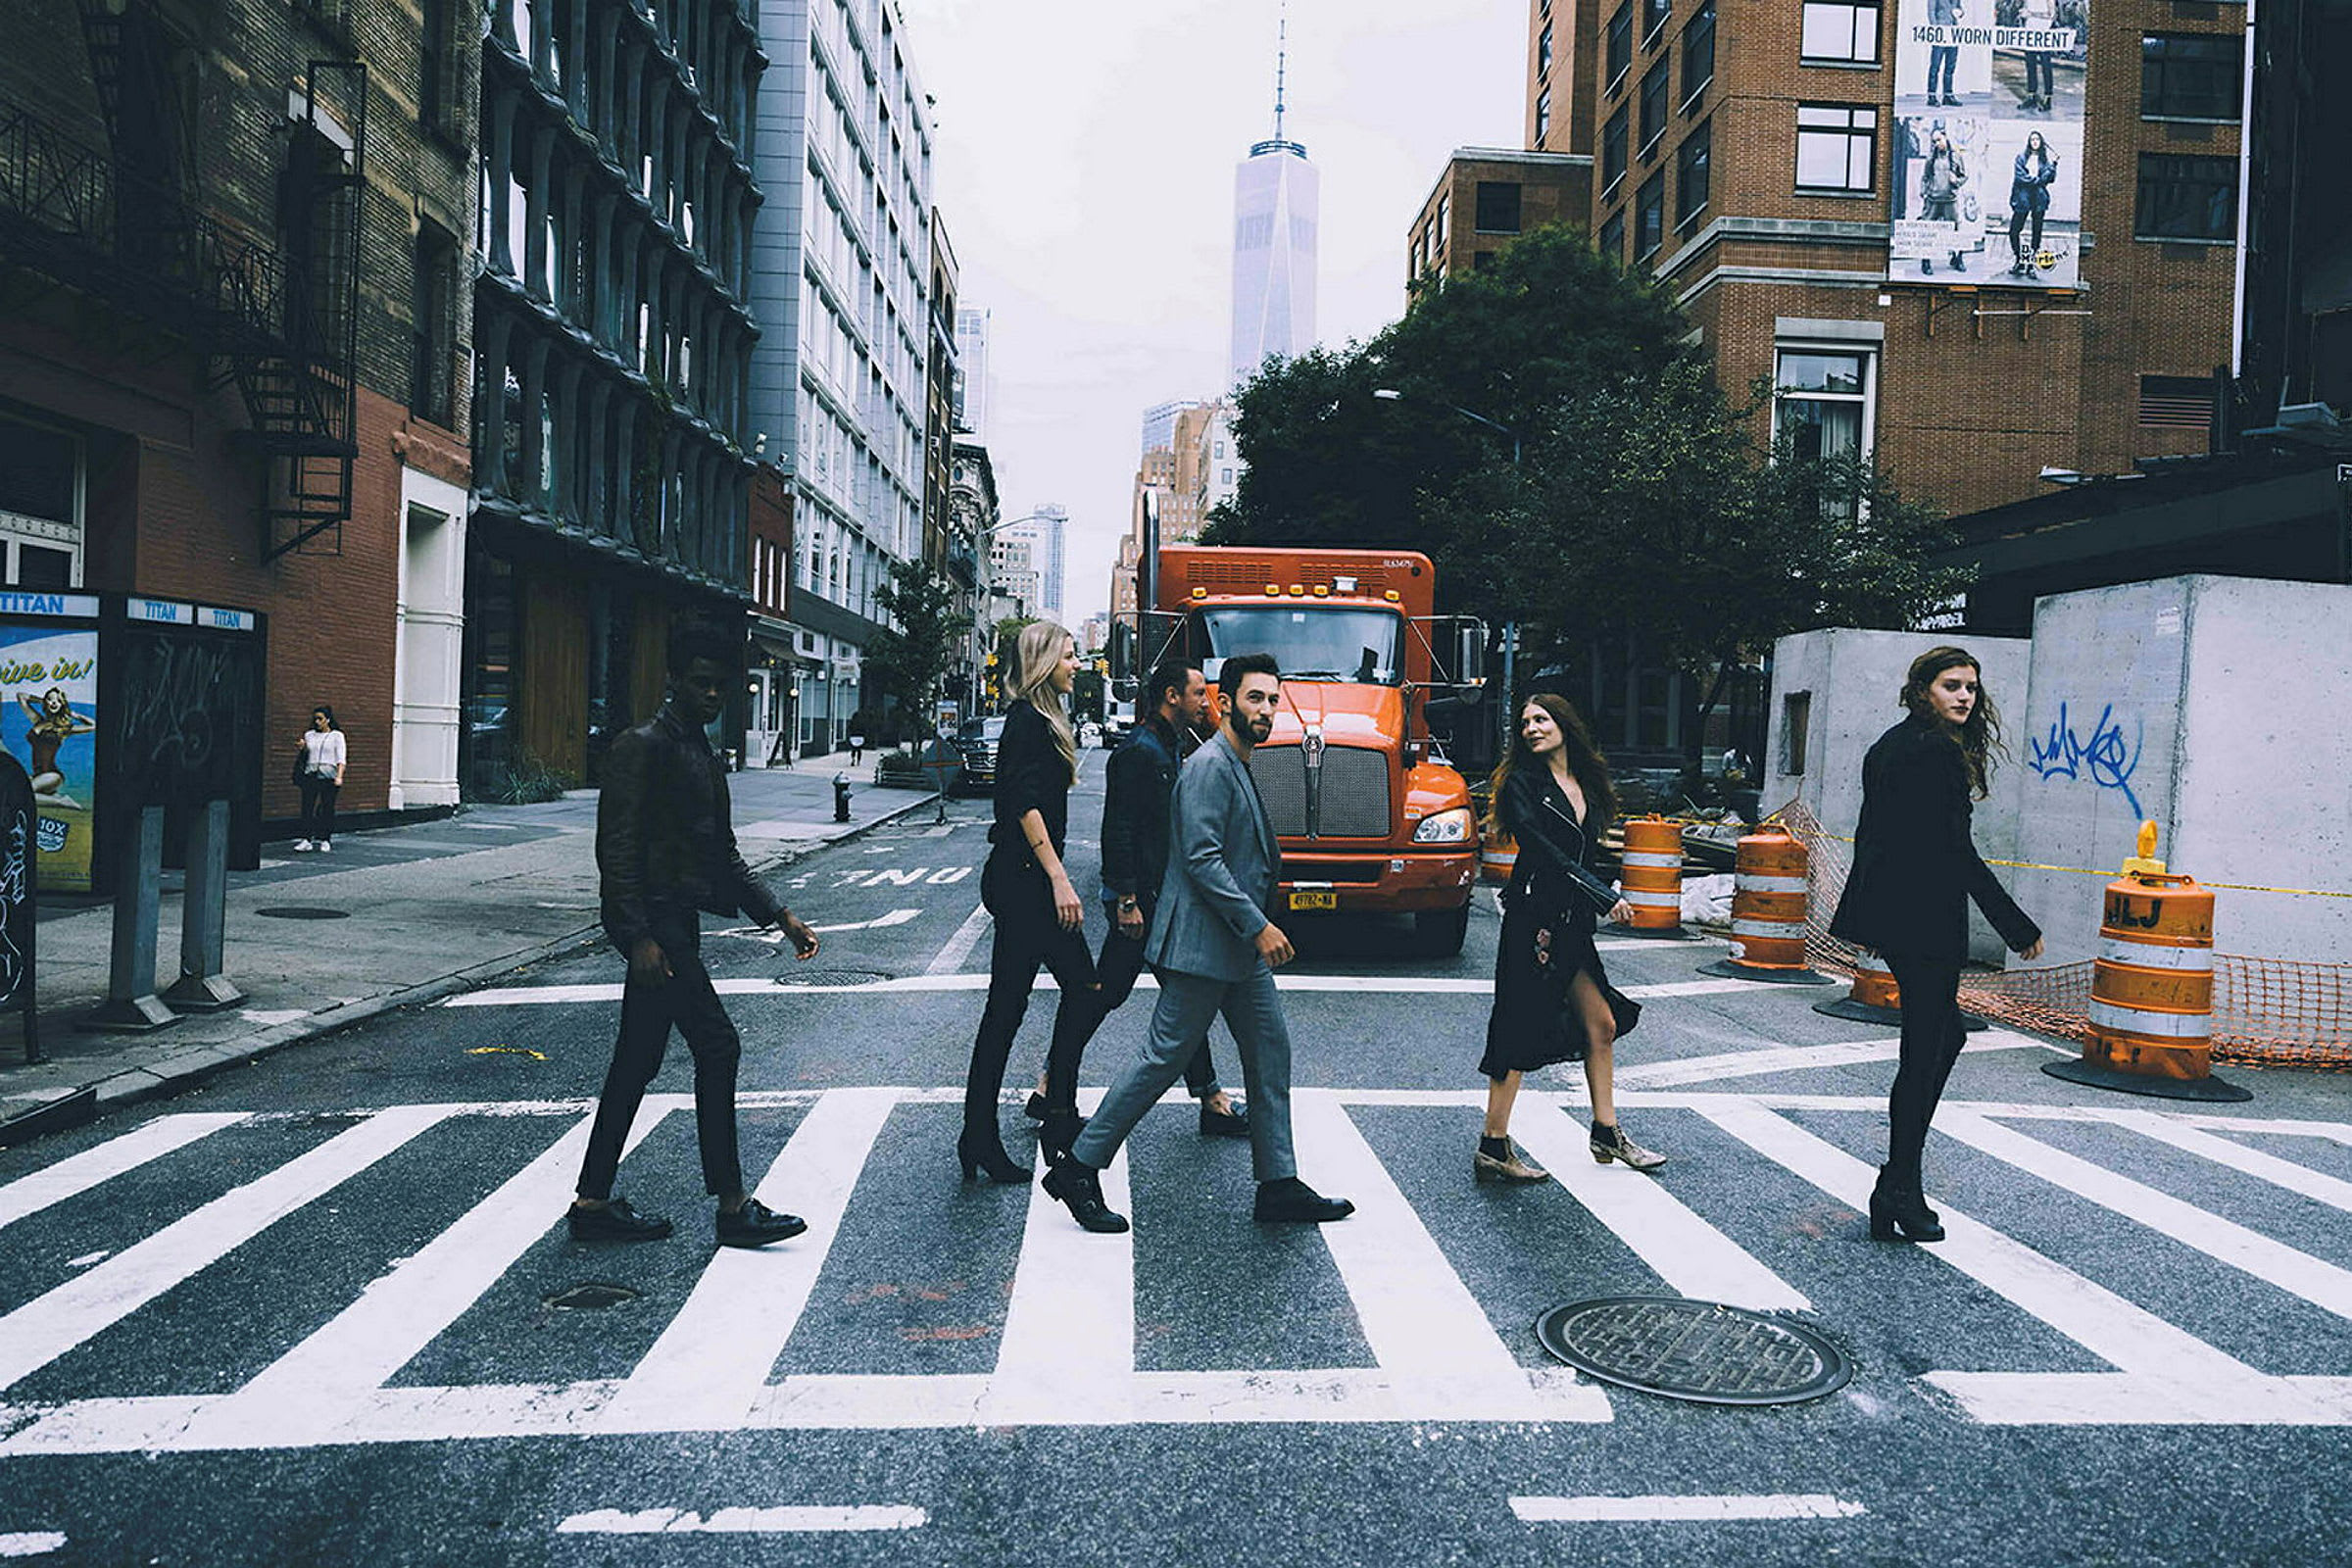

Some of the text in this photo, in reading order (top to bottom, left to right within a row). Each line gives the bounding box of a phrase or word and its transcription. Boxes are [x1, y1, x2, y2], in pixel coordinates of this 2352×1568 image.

[1912, 25, 2070, 48] 1460. WORN DIFFERENT
[0, 593, 65, 613] TITAN
[144, 601, 176, 620] TITAN
[213, 609, 241, 627] TITAN
[0, 659, 47, 684] ive
